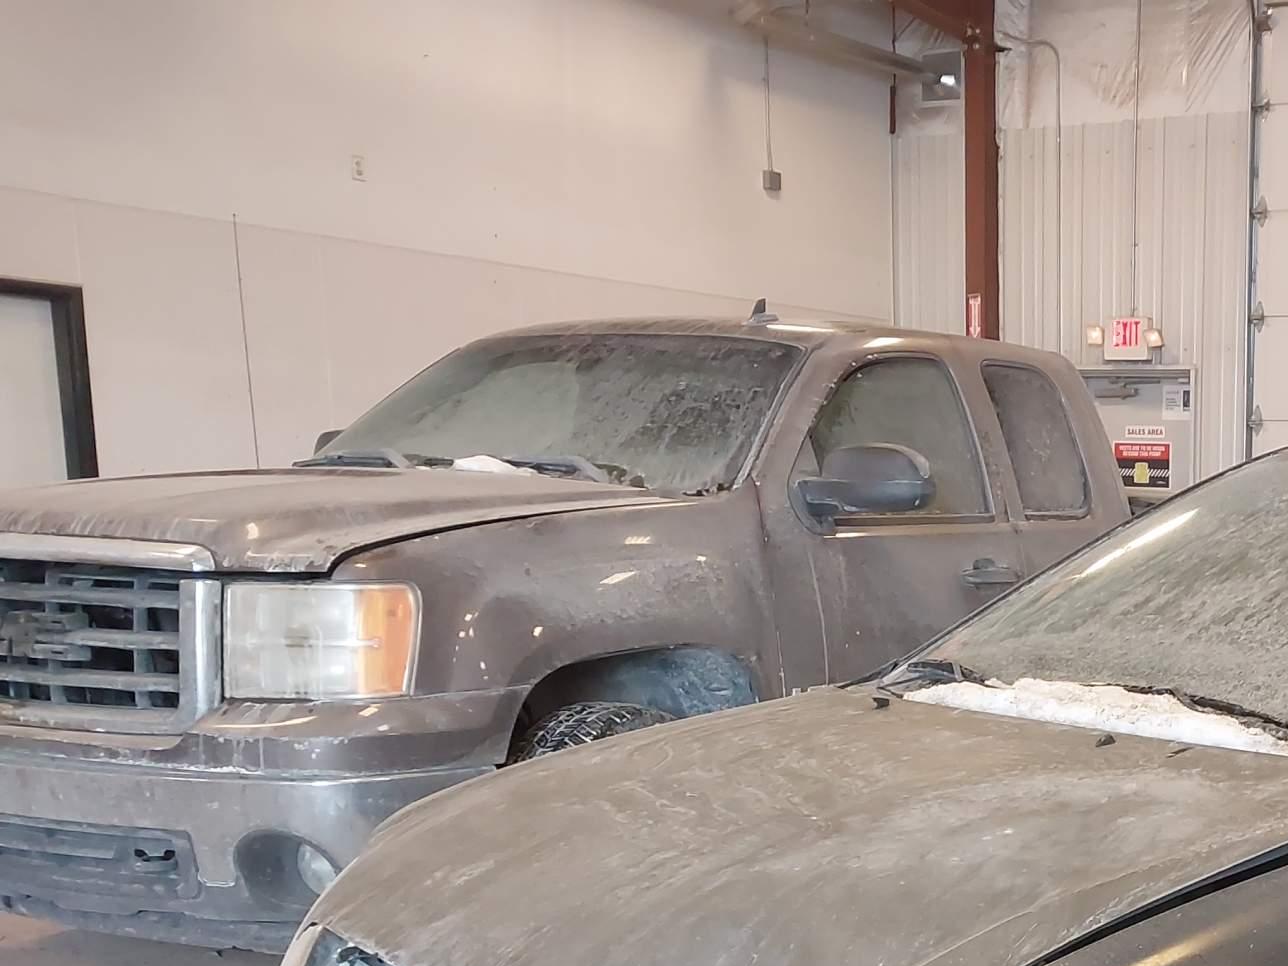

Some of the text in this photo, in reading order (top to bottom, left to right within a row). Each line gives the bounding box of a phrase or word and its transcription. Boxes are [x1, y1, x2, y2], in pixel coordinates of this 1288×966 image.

[1113, 320, 1141, 347] EXIT
[1127, 428, 1164, 436] SALES AREA
